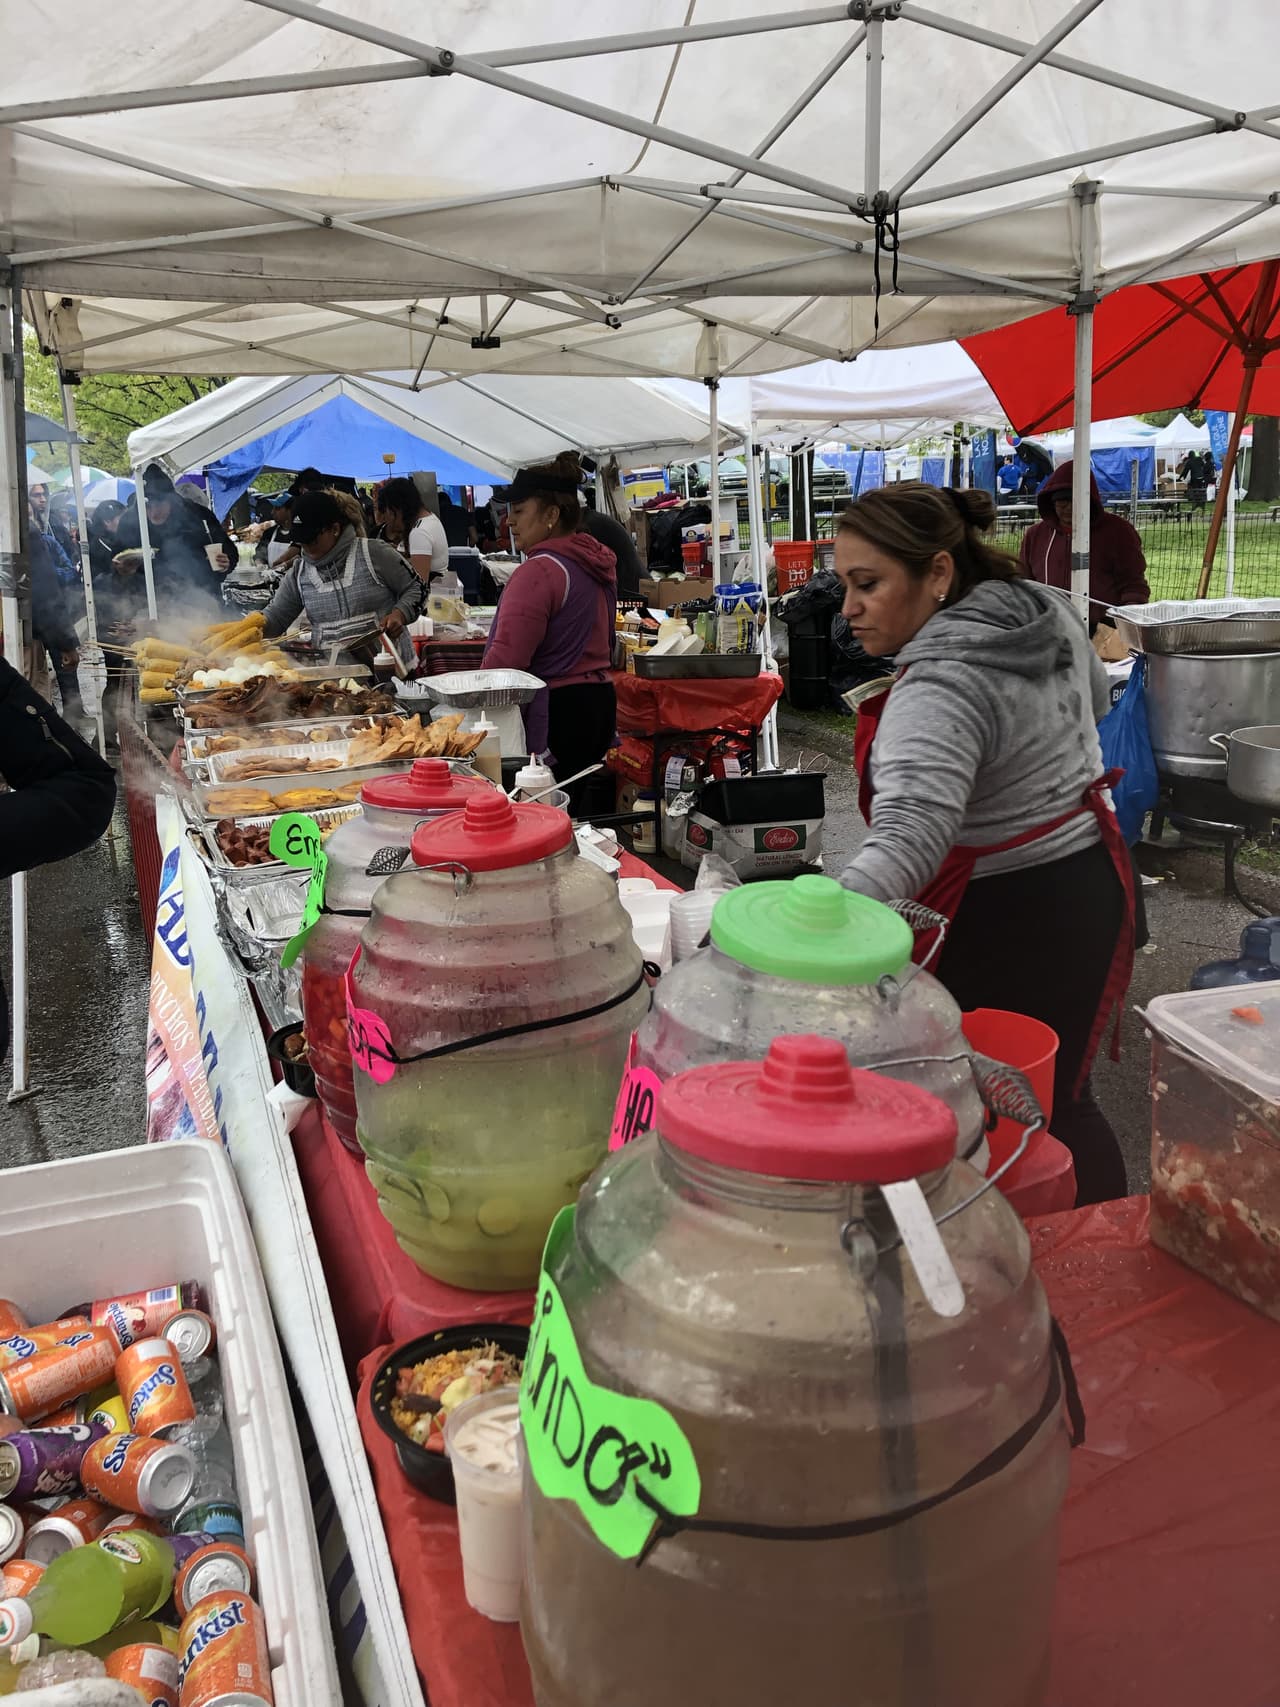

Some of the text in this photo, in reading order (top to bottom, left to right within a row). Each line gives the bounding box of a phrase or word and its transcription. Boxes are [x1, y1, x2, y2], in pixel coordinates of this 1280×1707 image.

[151, 971, 194, 1051] PINCHOS
[110, 1302, 134, 1345] Snapple
[128, 1363, 177, 1426] Sunkist
